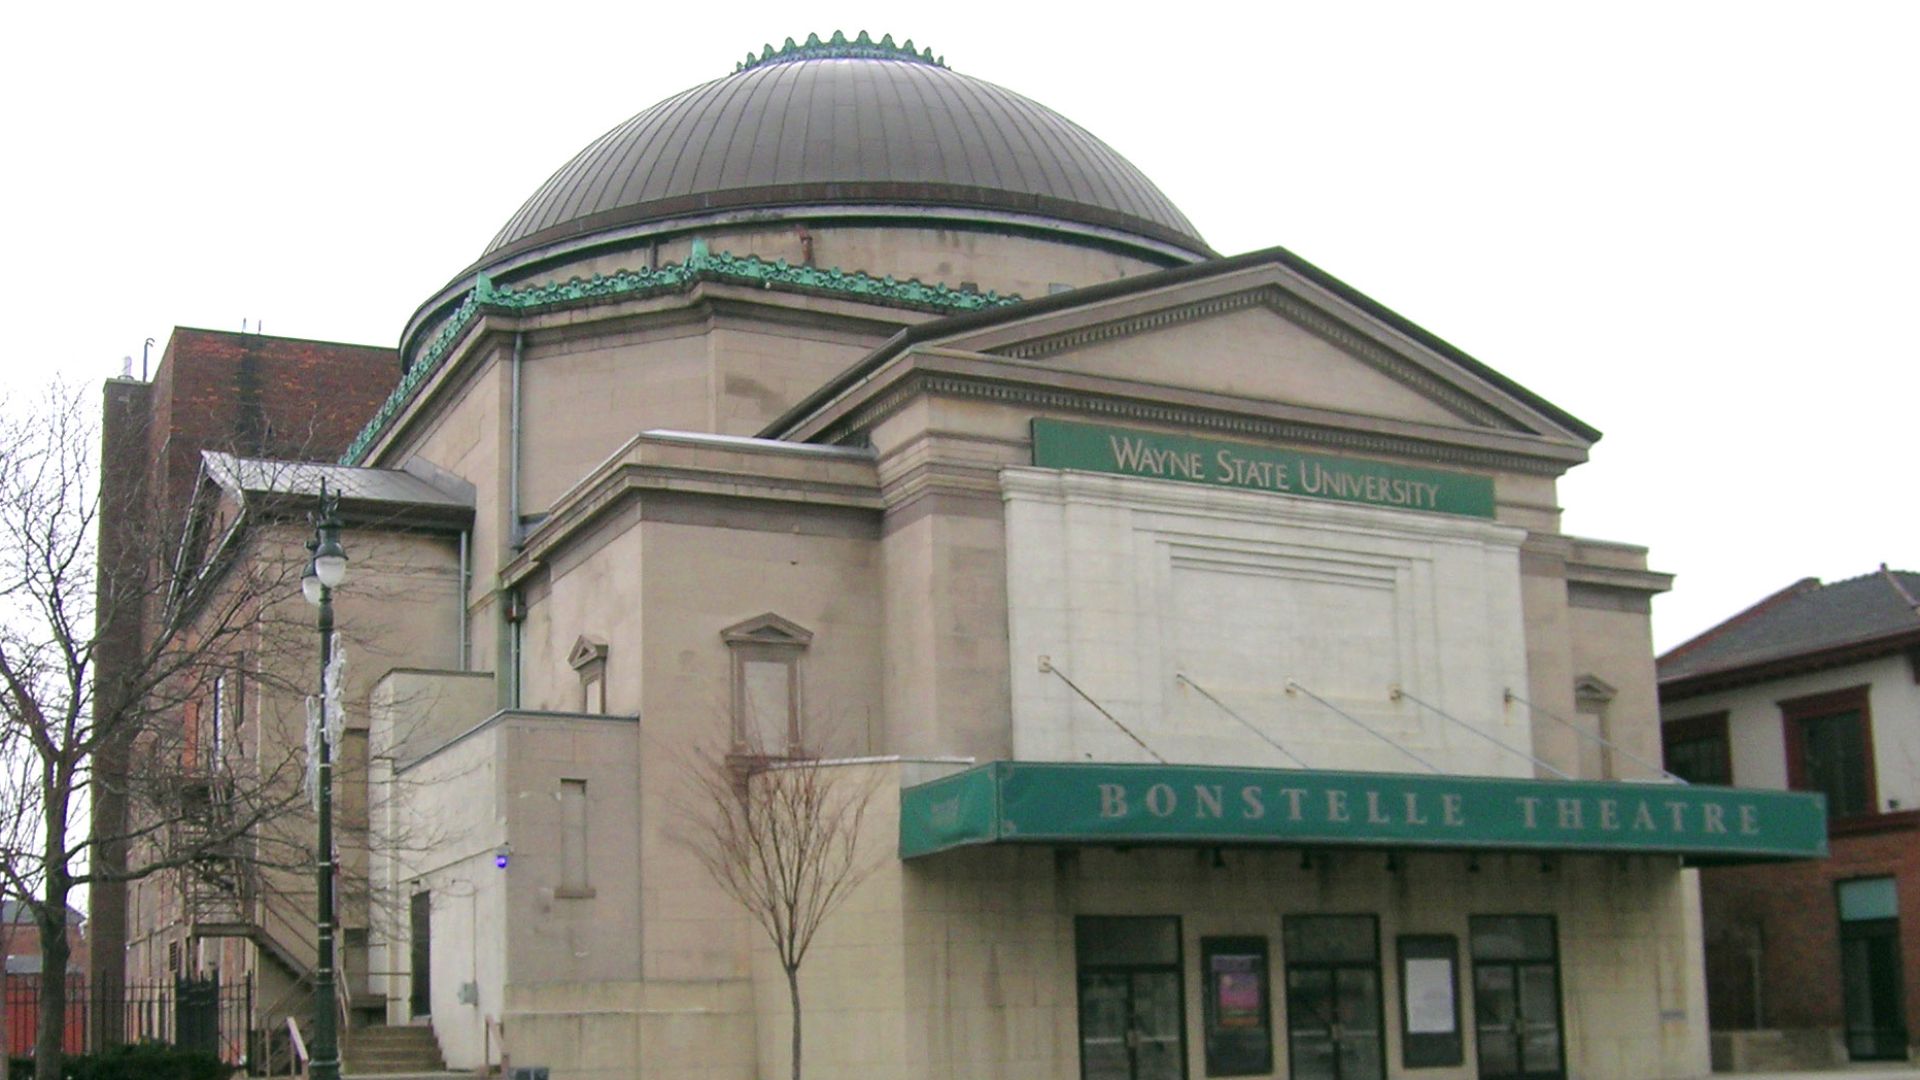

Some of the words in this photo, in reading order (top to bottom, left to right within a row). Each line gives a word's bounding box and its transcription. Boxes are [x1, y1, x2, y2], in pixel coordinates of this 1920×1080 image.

[1110, 436, 1204, 480] WAYNE
[1217, 449, 1290, 491] STATE
[1300, 463, 1440, 507] UNIVERSITY
[1098, 783, 1465, 826] BONSTELLE
[1516, 795, 1760, 835] THEATRE
